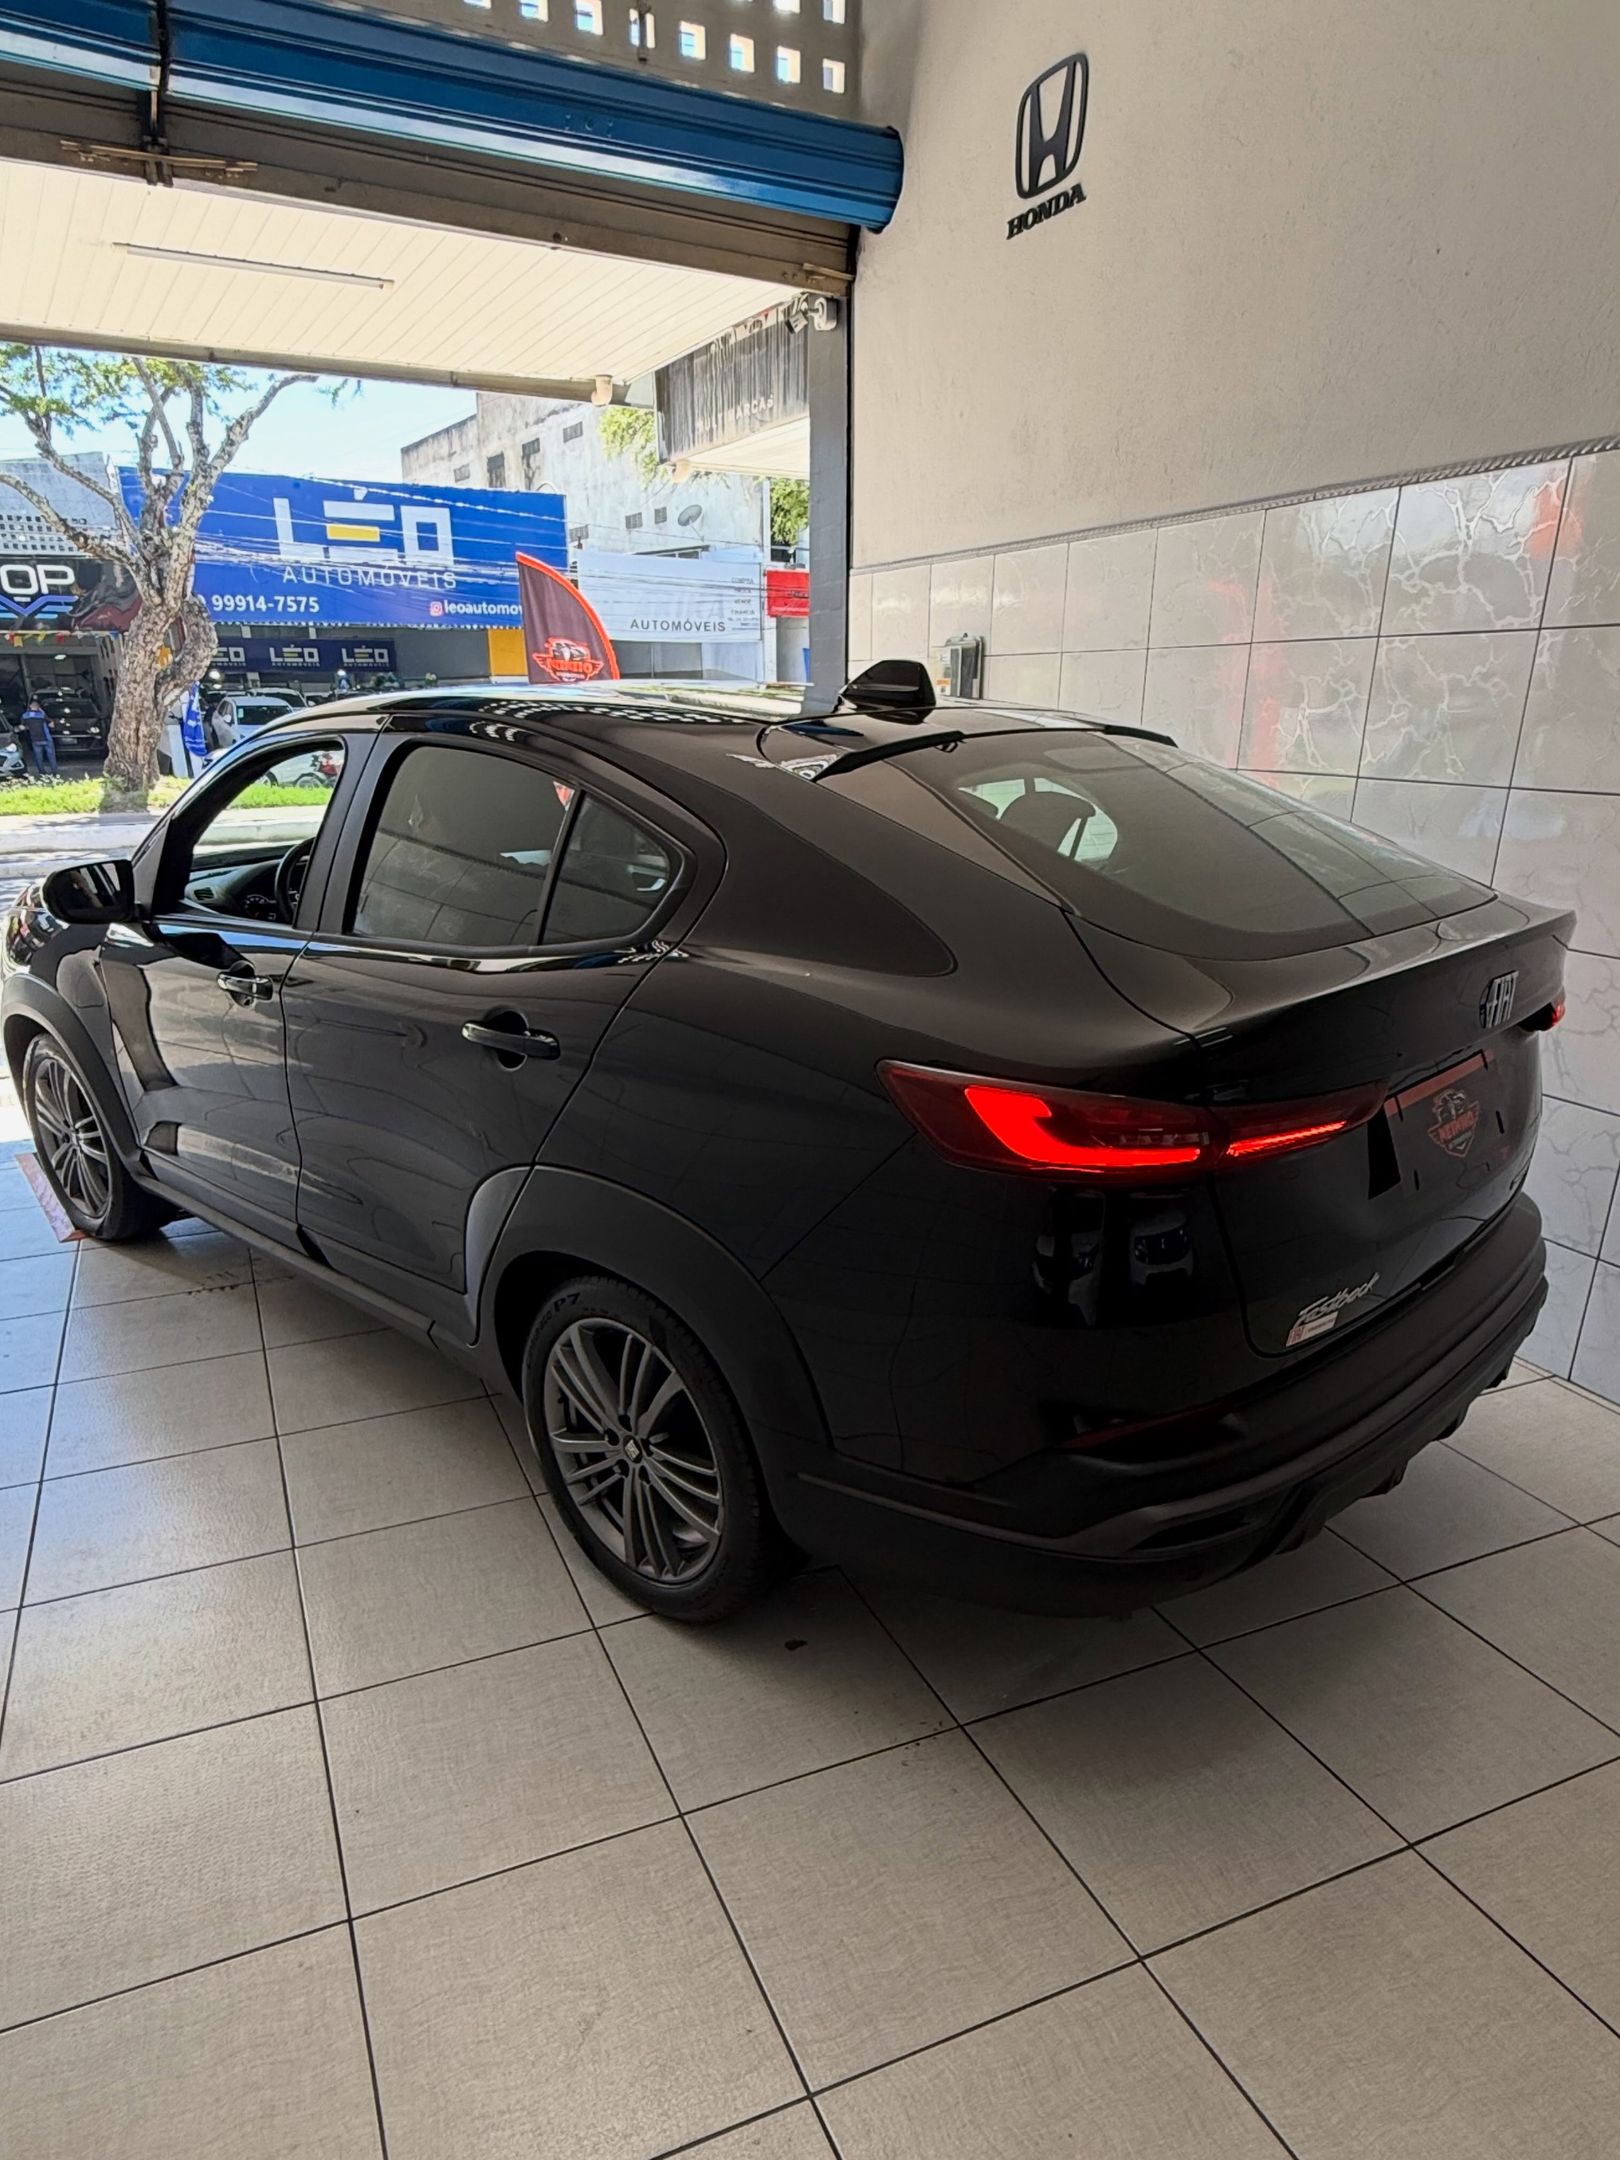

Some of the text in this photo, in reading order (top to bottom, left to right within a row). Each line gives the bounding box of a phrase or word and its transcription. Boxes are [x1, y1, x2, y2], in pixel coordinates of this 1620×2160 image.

[1006, 183, 1086, 240] HONDA
[0, 564, 75, 594] OP
[211, 594, 320, 613] 99914-7575
[444, 599, 522, 616] leoautomov
[630, 618, 726, 632] AUTOMÓVEIS
[1486, 971, 1519, 1029] FIAT
[1293, 1272, 1380, 1328] Fastback
